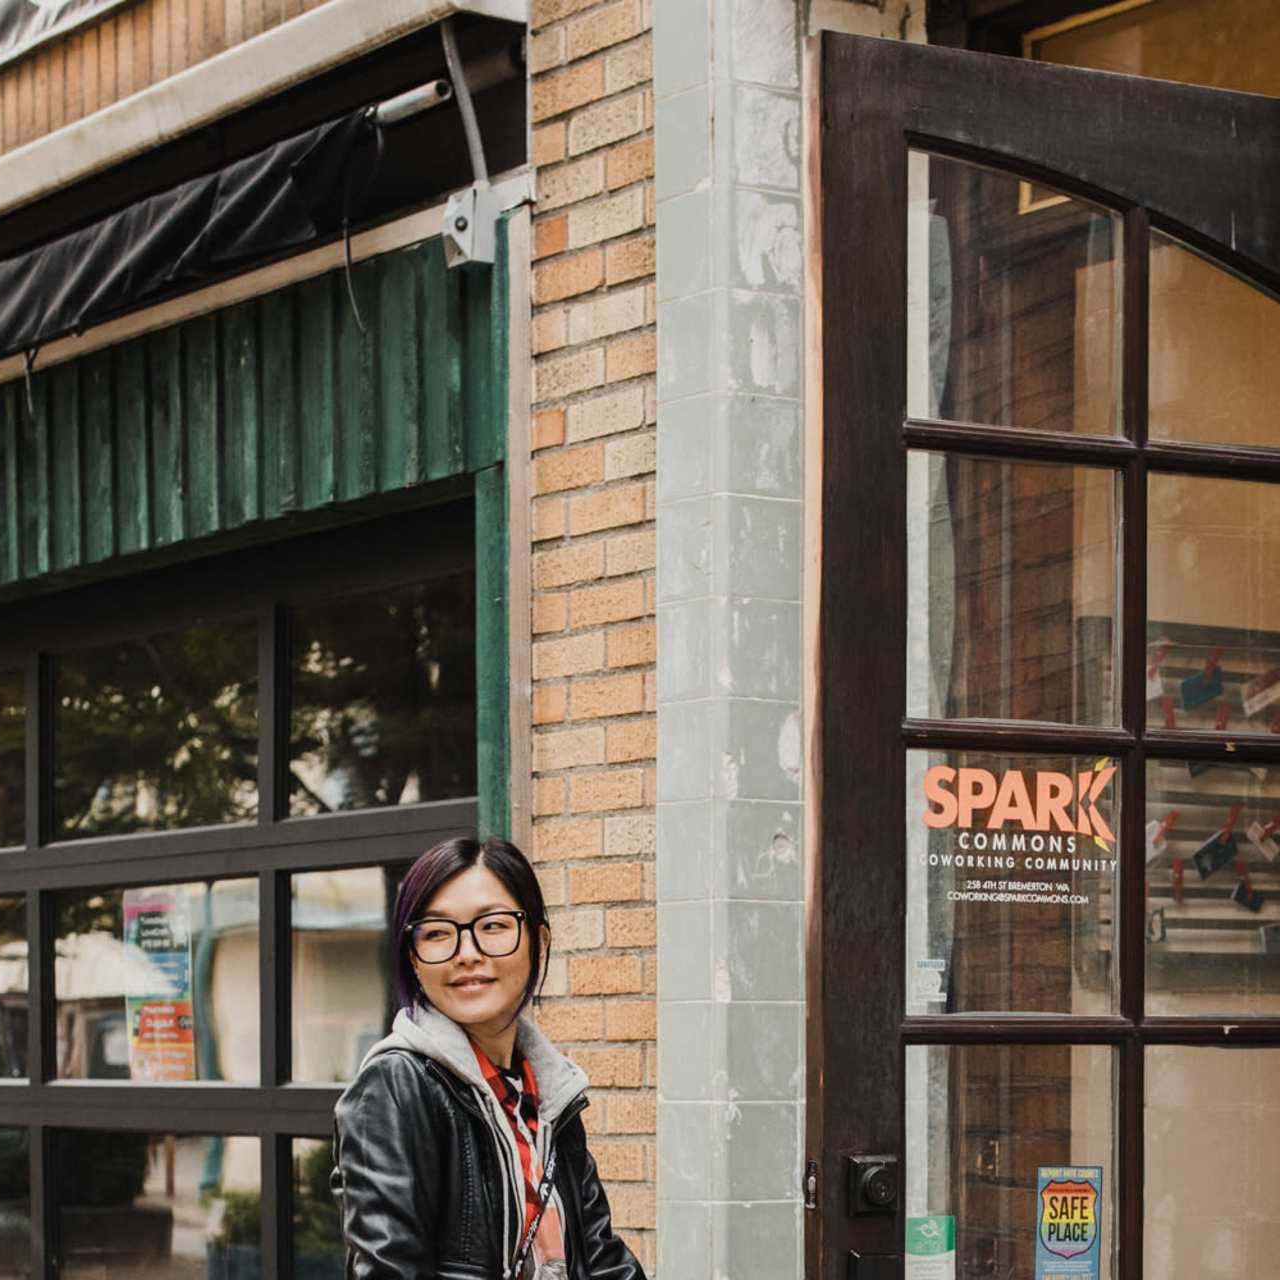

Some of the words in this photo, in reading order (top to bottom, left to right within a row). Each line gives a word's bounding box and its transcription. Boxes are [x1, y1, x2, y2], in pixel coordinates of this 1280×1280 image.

[922, 765, 1118, 842] SPARK
[958, 832, 1077, 853] COMMONS
[919, 854, 1015, 869] COWORKING
[1024, 857, 1118, 872] COMMUNITY
[982, 880, 997, 890] 4TH
[998, 881, 1007, 890] ST
[1008, 881, 1052, 892] BREMERTON
[1049, 1195, 1089, 1220] SAFE
[1047, 1222, 1089, 1242] PLACE
